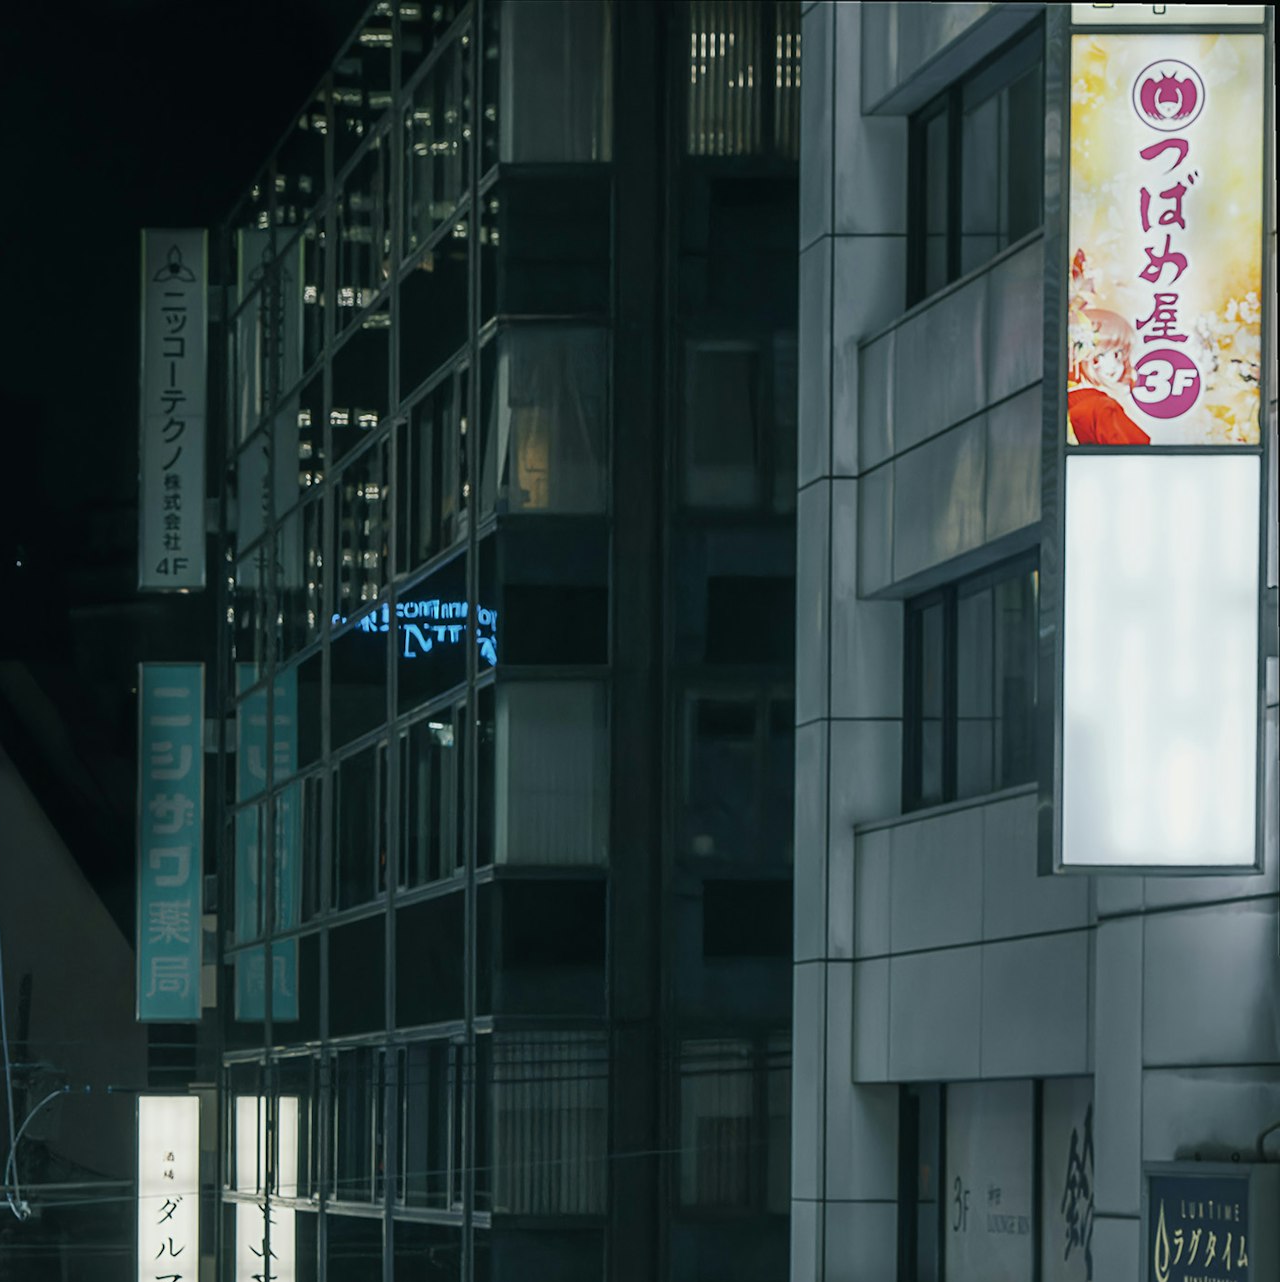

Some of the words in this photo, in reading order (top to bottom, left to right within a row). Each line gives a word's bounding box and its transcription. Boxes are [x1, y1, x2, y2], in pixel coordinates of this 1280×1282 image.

[1136, 137, 1199, 343] つばめ屋
[1132, 360, 1198, 404] 3F
[155, 556, 188, 576] 4F
